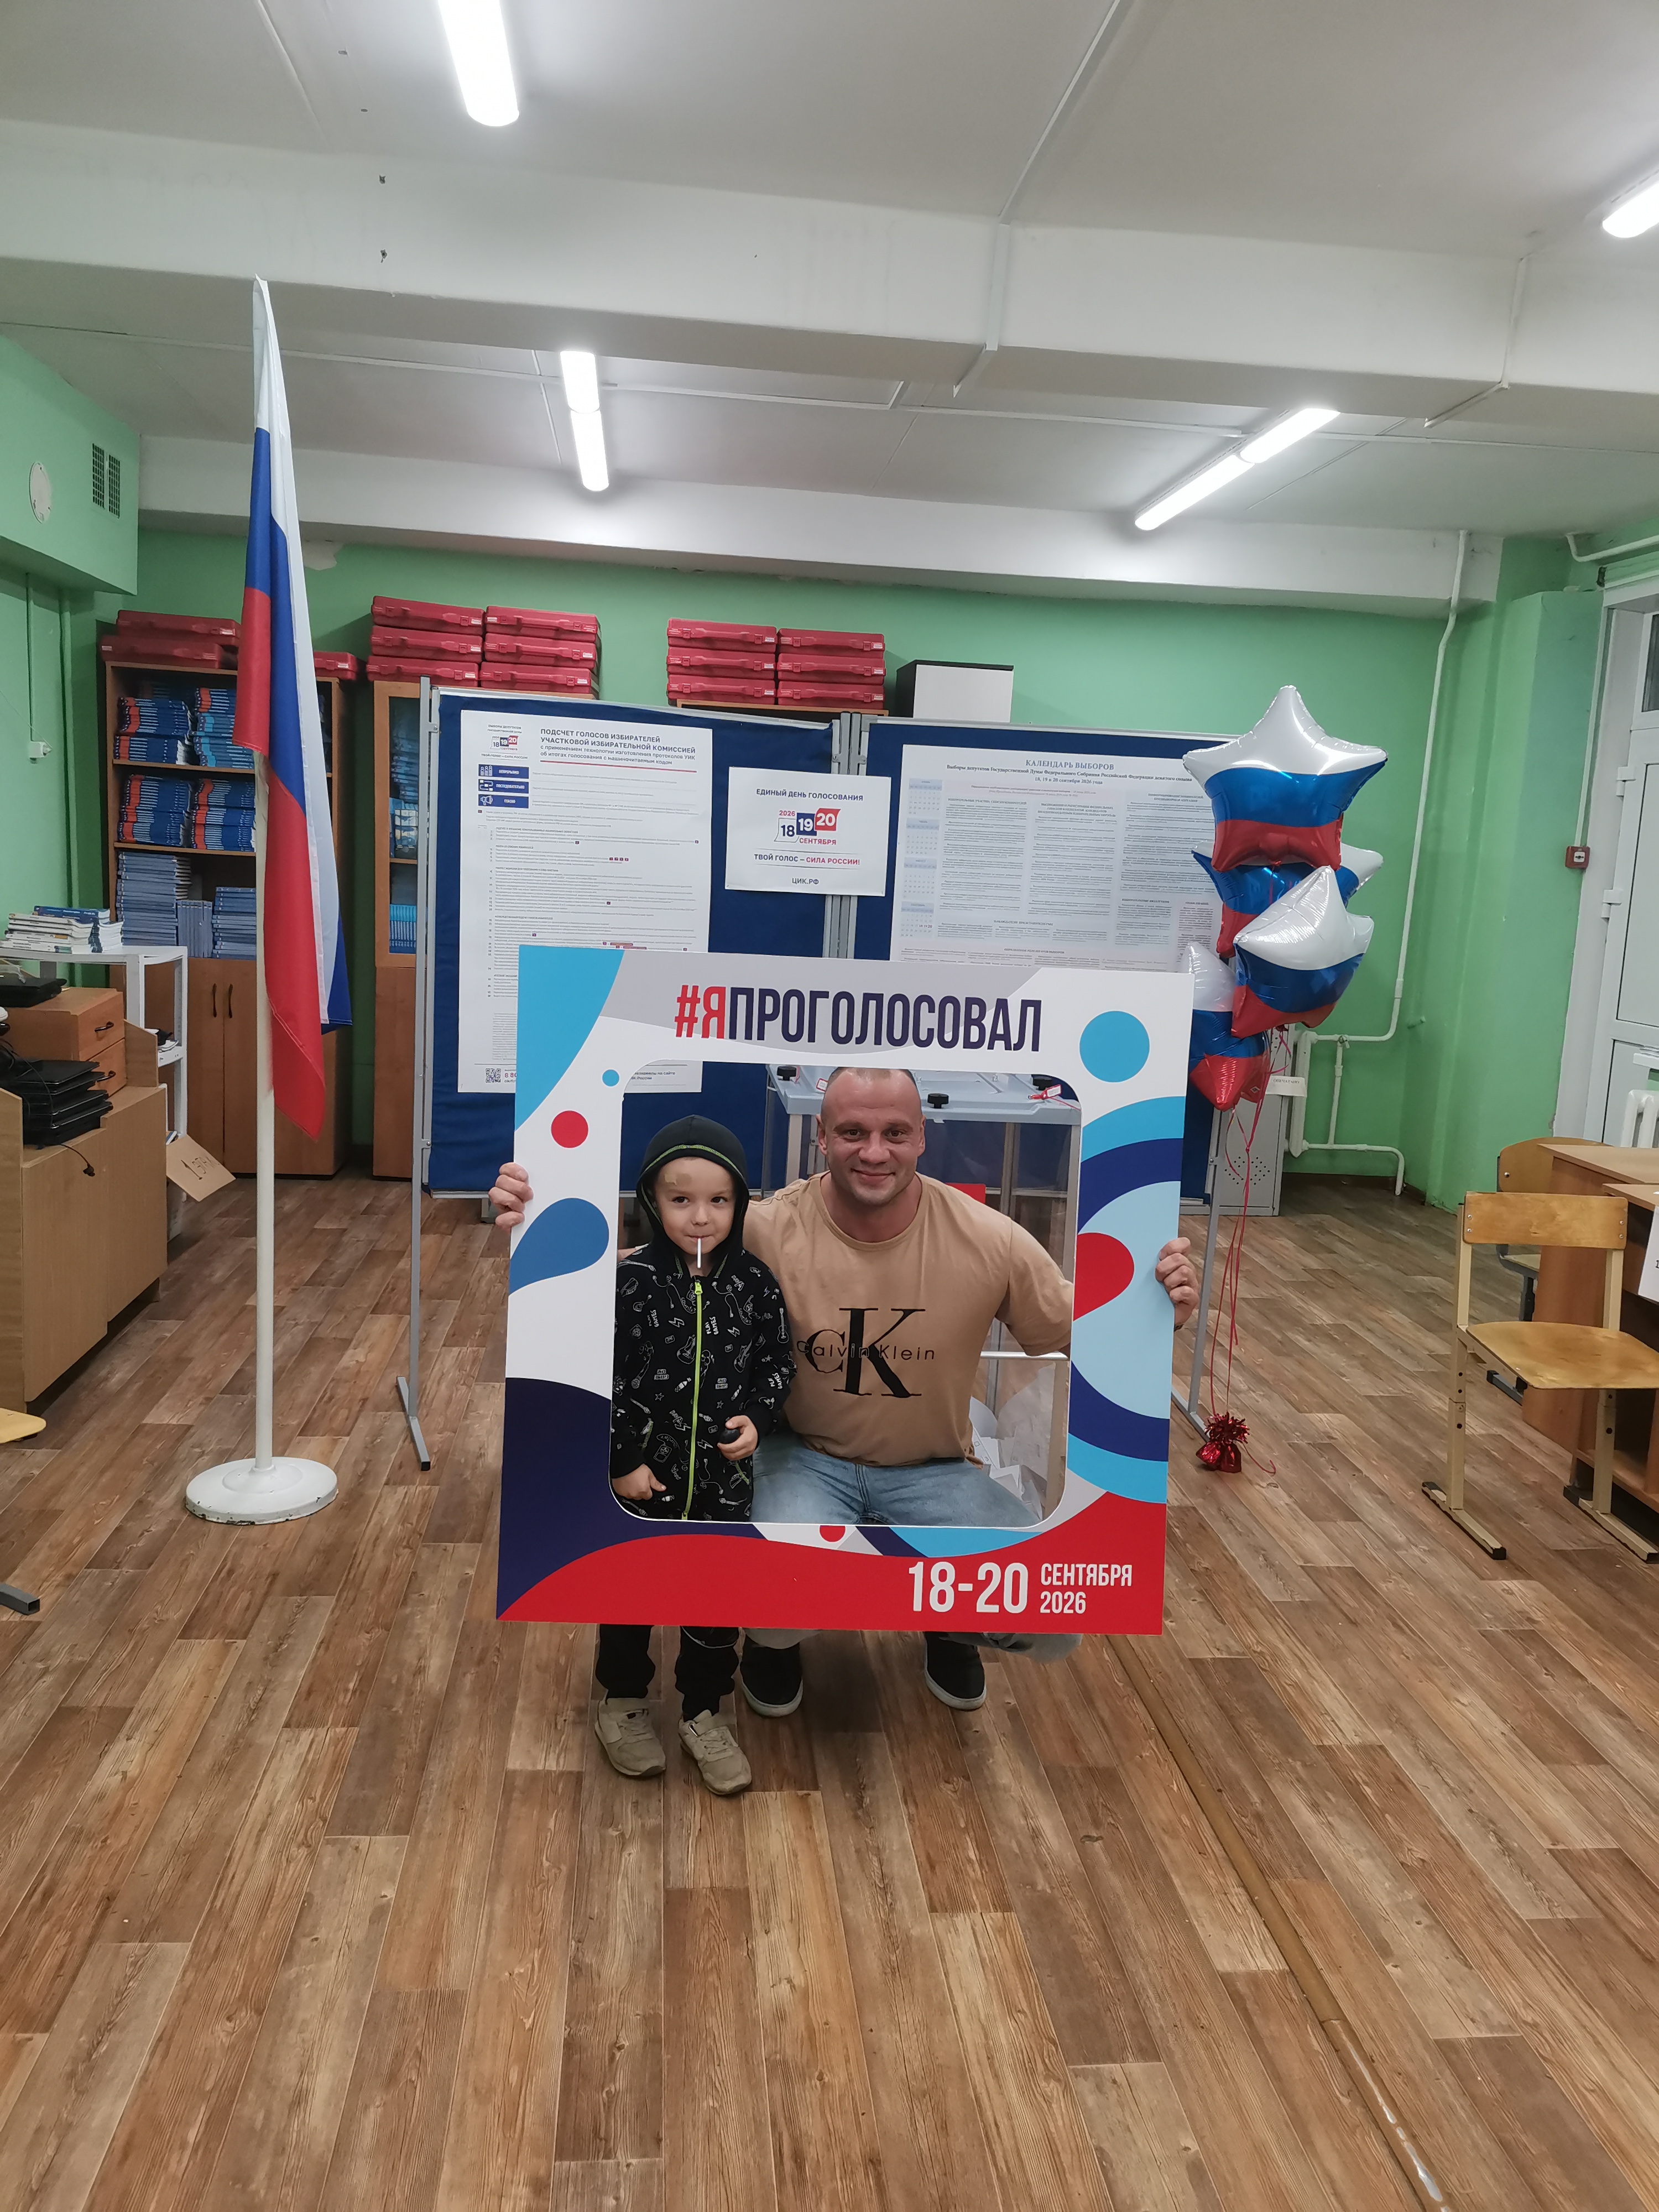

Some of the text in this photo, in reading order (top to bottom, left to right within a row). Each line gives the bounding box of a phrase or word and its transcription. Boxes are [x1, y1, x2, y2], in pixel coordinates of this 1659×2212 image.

[540, 737, 696, 754] УЧАСТКОВОЙ ИЗБИРАТЕЛЬНОЙ КОМИССИЕЙ
[576, 731, 609, 739] ГОЛОСОВ
[611, 733, 660, 743] ИЗБИРАТЕЛЕЙ
[1025, 759, 1114, 770] КАЛЕНДАРЬ ВЫБОРОВ
[756, 788, 787, 797] ЕДИНЫЙ
[808, 792, 863, 801] ГОЛОСОВАНИЯ
[798, 818, 813, 832] 19
[816, 813, 836, 826] 20
[781, 825, 795, 837] 18
[674, 985, 1042, 1052] #ЯПРОГОЛОСОВАЛ
[650, 1310, 659, 1327] GAMES
[709, 1316, 719, 1335] GAMES
[796, 1340, 935, 1360] Calvin Klein
[772, 1373, 783, 1389] GAMES
[1040, 1563, 1133, 1587] СЕНТЯБРЯ
[909, 1561, 1029, 1614] 18-20
[1040, 1592, 1086, 1614] 2026
